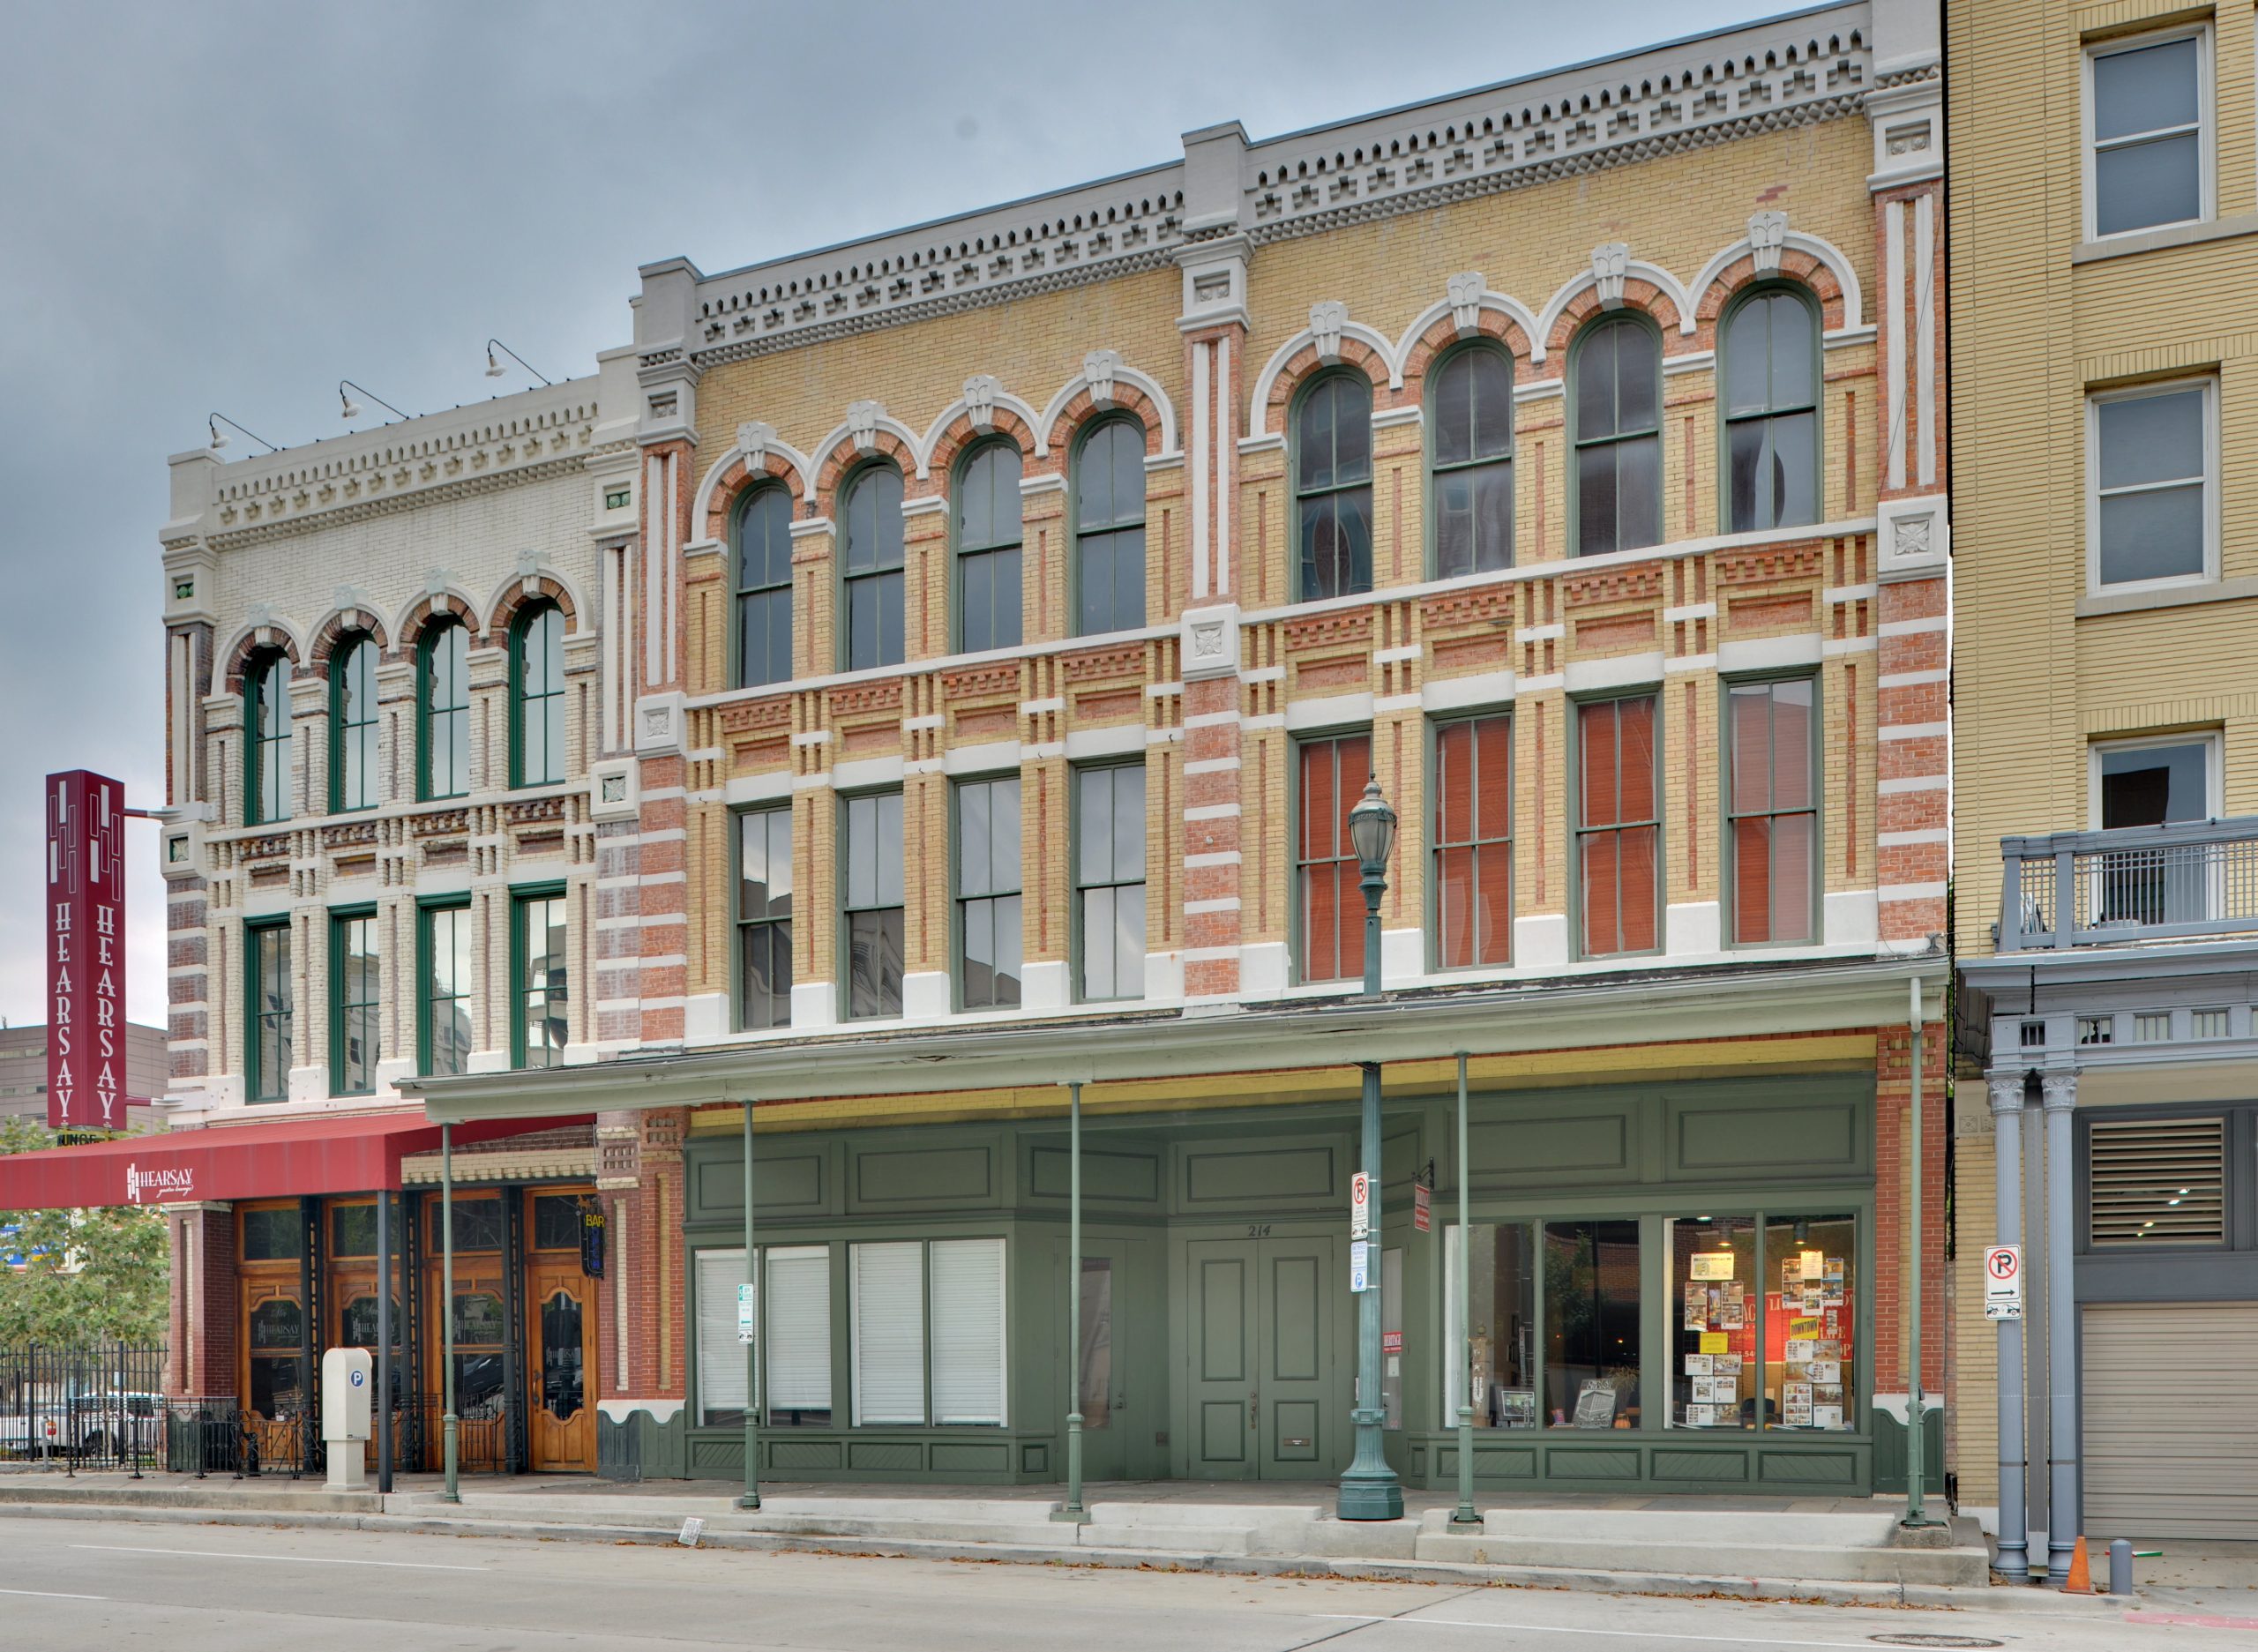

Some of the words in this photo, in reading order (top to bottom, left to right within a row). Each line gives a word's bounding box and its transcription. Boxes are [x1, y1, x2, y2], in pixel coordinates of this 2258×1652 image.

[56, 902, 72, 1118] HEARSAY
[96, 904, 116, 1119] HEARSAY
[140, 1168, 193, 1187] HEARSAY
[586, 1214, 605, 1228] BAR
[1249, 1225, 1271, 1237] 214
